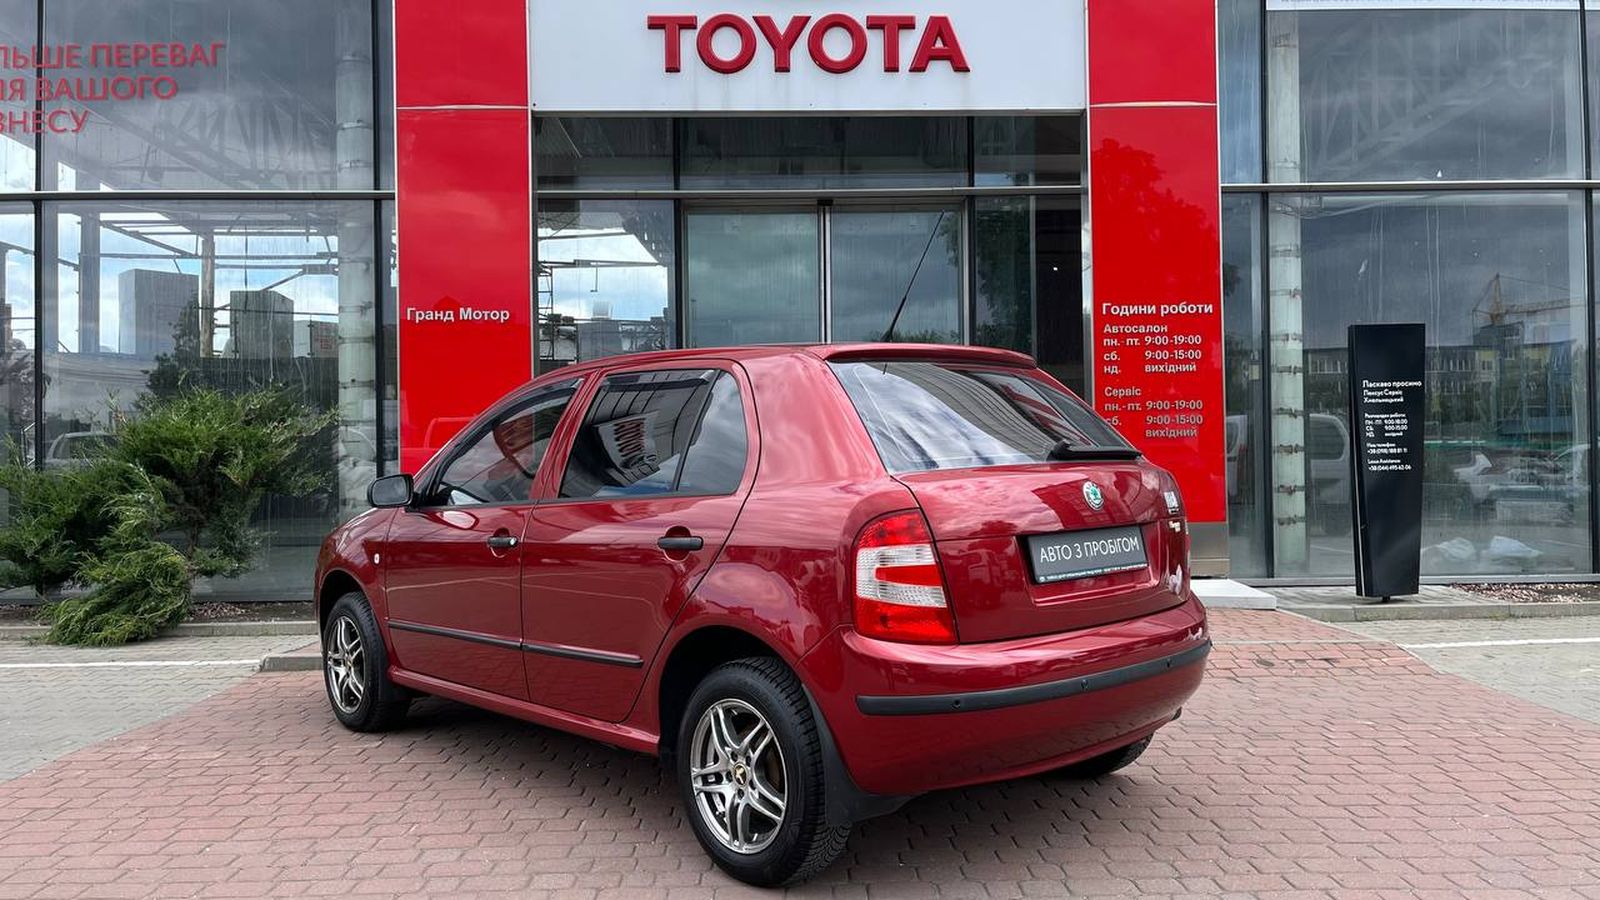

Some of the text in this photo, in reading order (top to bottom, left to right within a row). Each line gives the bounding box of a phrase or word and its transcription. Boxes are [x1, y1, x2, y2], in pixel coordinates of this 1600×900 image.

[647, 13, 970, 73] TOYOTA
[90, 42, 225, 68] ПЕРЕВАГ
[0, 75, 178, 101] Я ВАШОГО
[406, 307, 510, 324] Гранд Мотор
[1102, 301, 1213, 317] Години роботи
[1103, 324, 1168, 334] Автосалон
[1103, 351, 1121, 361] сб.
[1103, 361, 1197, 375] нд. вихідний
[1104, 386, 1142, 399] Сервіс
[1145, 425, 1198, 439] вихідний
[1040, 544, 1073, 563] АВТО
[1083, 536, 1140, 557] ПРОБІГОМ
